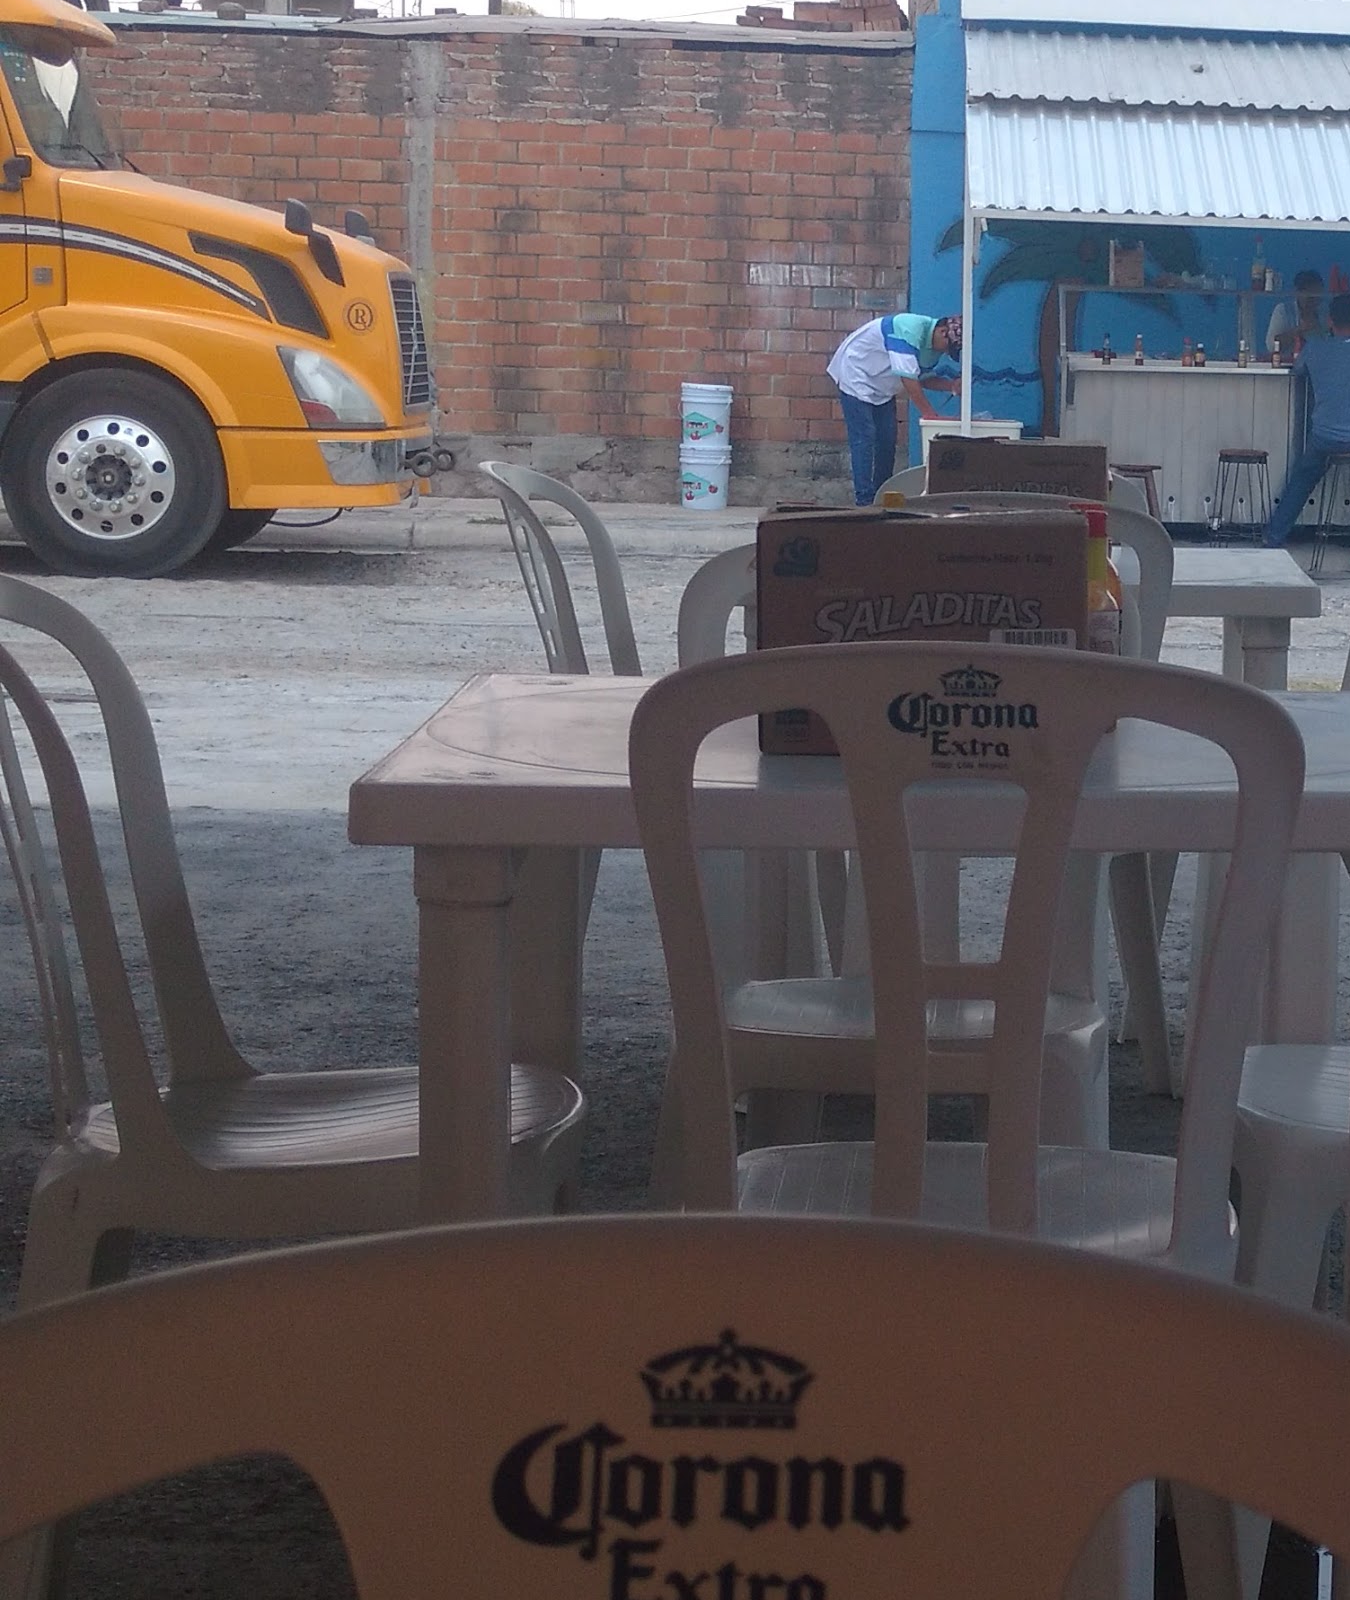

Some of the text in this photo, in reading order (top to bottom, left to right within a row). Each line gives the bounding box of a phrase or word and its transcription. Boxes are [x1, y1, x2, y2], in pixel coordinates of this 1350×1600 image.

[815, 591, 1041, 643] SALADITAS
[888, 692, 1039, 737] Corona
[931, 731, 1010, 757] Extra
[491, 1421, 911, 1562] Corona
